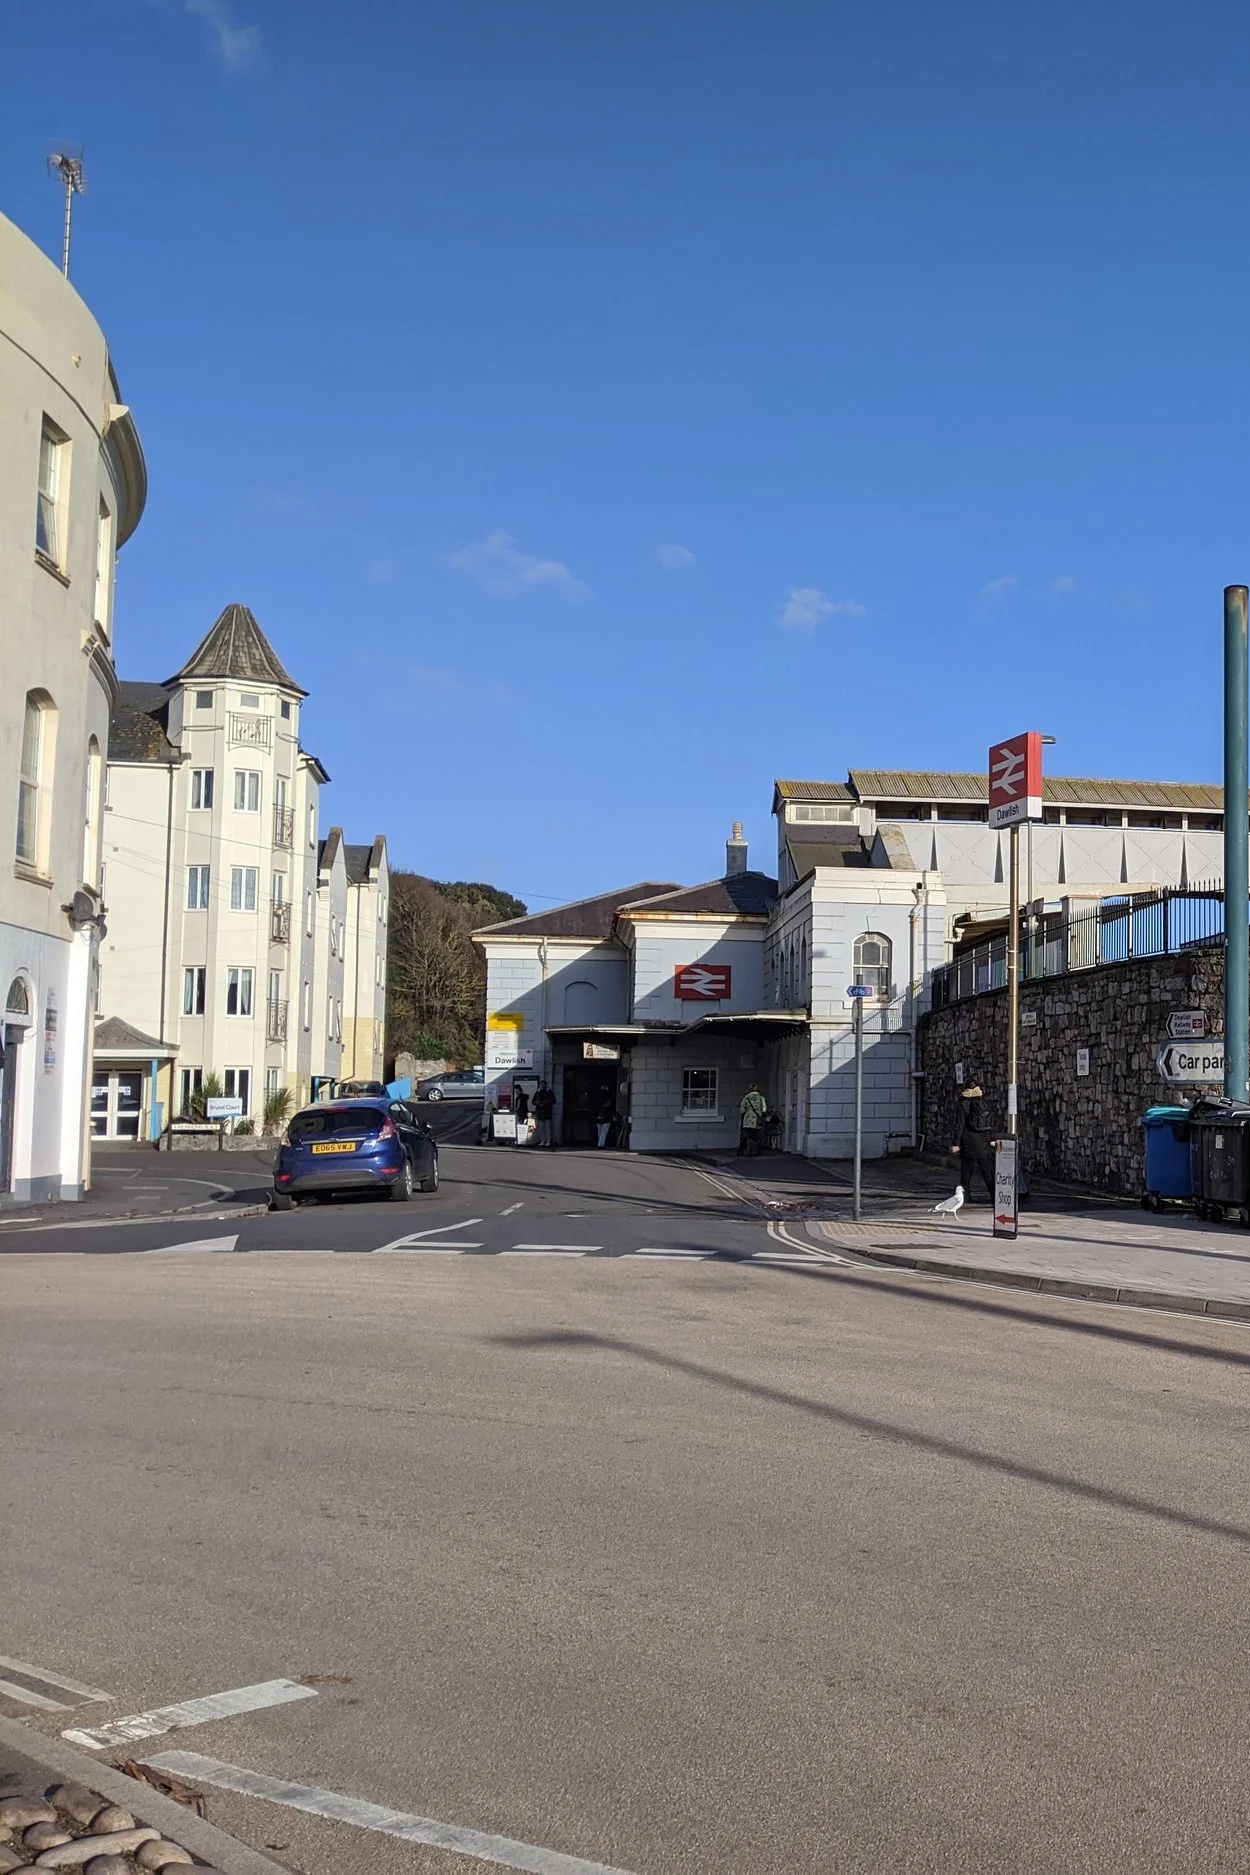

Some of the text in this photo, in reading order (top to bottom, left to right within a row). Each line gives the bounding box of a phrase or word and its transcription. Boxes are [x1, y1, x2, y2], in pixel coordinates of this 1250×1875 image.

[996, 803, 1020, 820] Dawlish
[494, 1056, 526, 1064] Dawlish
[1178, 1053, 1225, 1074] Car par
[996, 1172, 1014, 1189] Charity
[998, 1190, 1012, 1208] Shop
